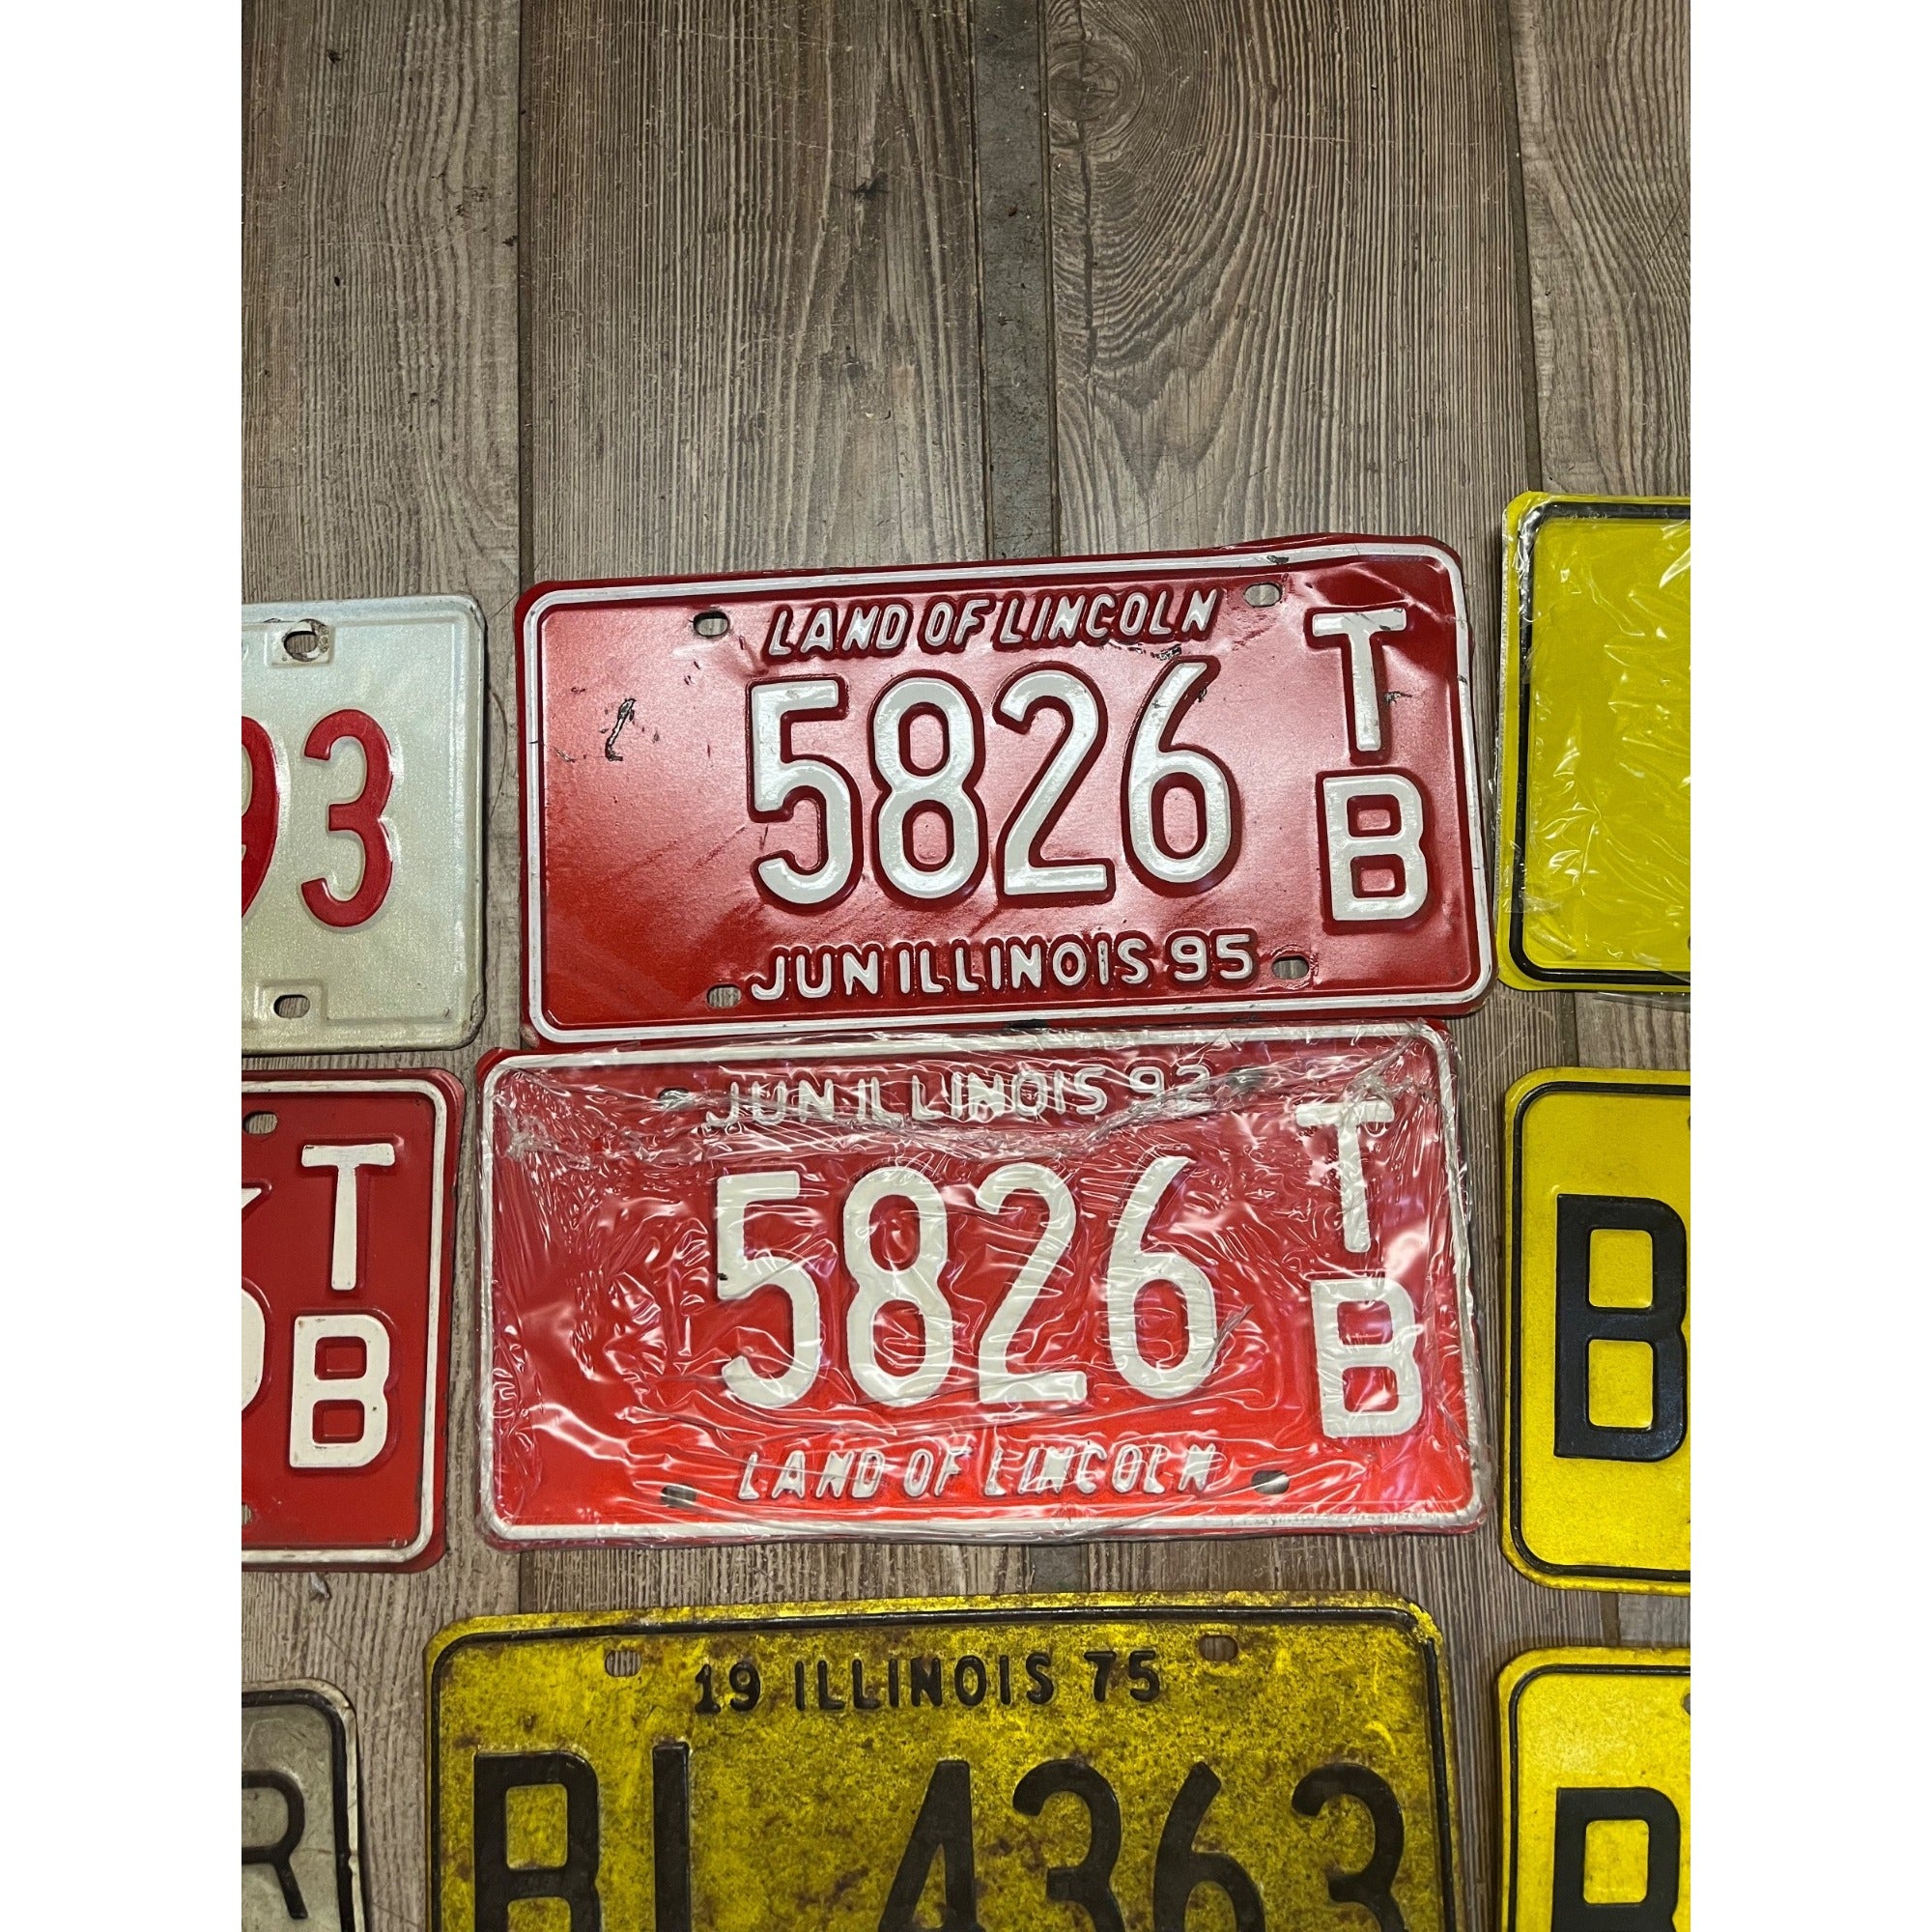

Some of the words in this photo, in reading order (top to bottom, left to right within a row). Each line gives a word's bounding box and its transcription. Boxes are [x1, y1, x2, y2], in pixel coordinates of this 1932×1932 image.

[769, 599, 907, 657] LAND
[926, 595, 985, 649] OF
[992, 587, 1218, 649] LINCOLN
[750, 661, 1234, 903] 5826
[751, 945, 873, 1001] JUN
[895, 934, 1148, 995] ILLINOIS
[1169, 932, 1253, 983] 95
[708, 1075, 838, 1127] JUN
[857, 1069, 1110, 1124] ILLINOIS
[715, 1156, 1218, 1410] 5826
[1553, 1194, 1687, 1463] B
[739, 1450, 888, 1502] LAND
[904, 1446, 974, 1497] OF
[983, 1442, 1218, 1499] LINCOLN
[694, 1661, 760, 1715] 19
[794, 1650, 1056, 1713] ILLINOIS
[1087, 1648, 1160, 1704] 75
[874, 1758, 1406, 1932] 4363
